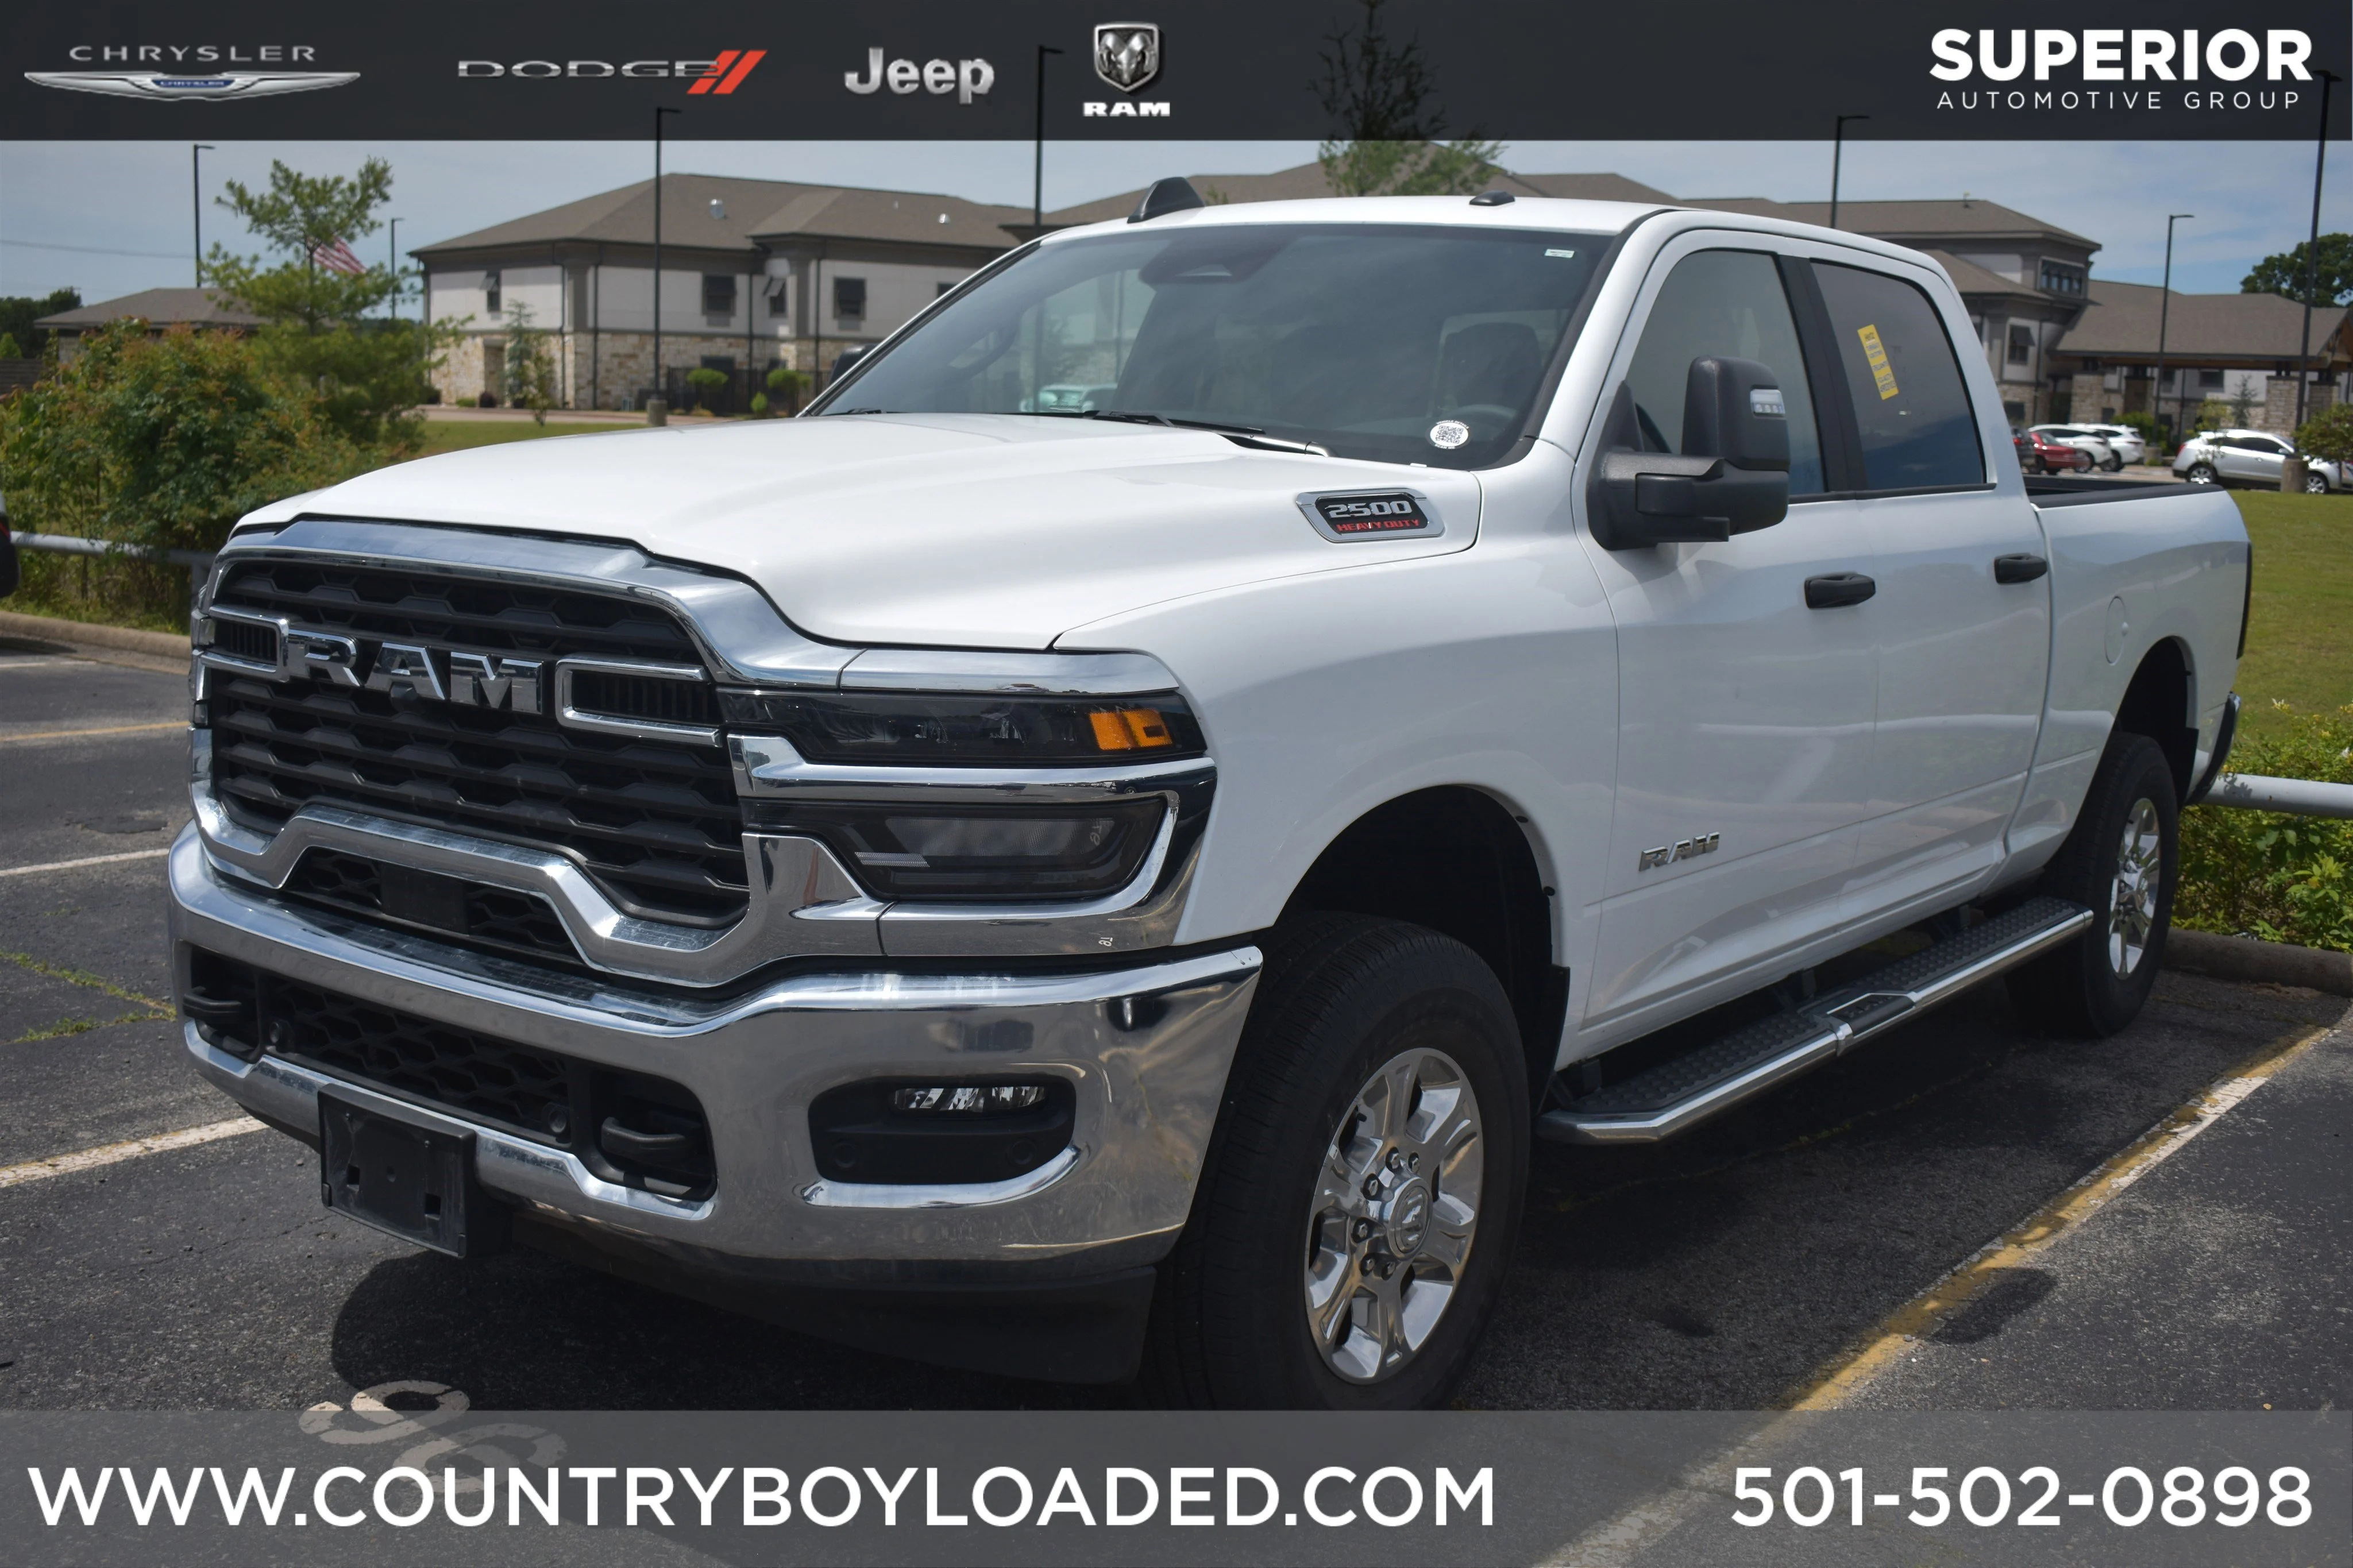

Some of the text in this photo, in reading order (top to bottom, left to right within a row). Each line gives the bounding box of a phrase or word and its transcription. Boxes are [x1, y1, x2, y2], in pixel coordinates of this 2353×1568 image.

[1325, 500, 1413, 518] 2500
[1336, 519, 1419, 532] HEAVY DUTY
[288, 629, 545, 715] RAM
[1639, 832, 1720, 871] RAM
